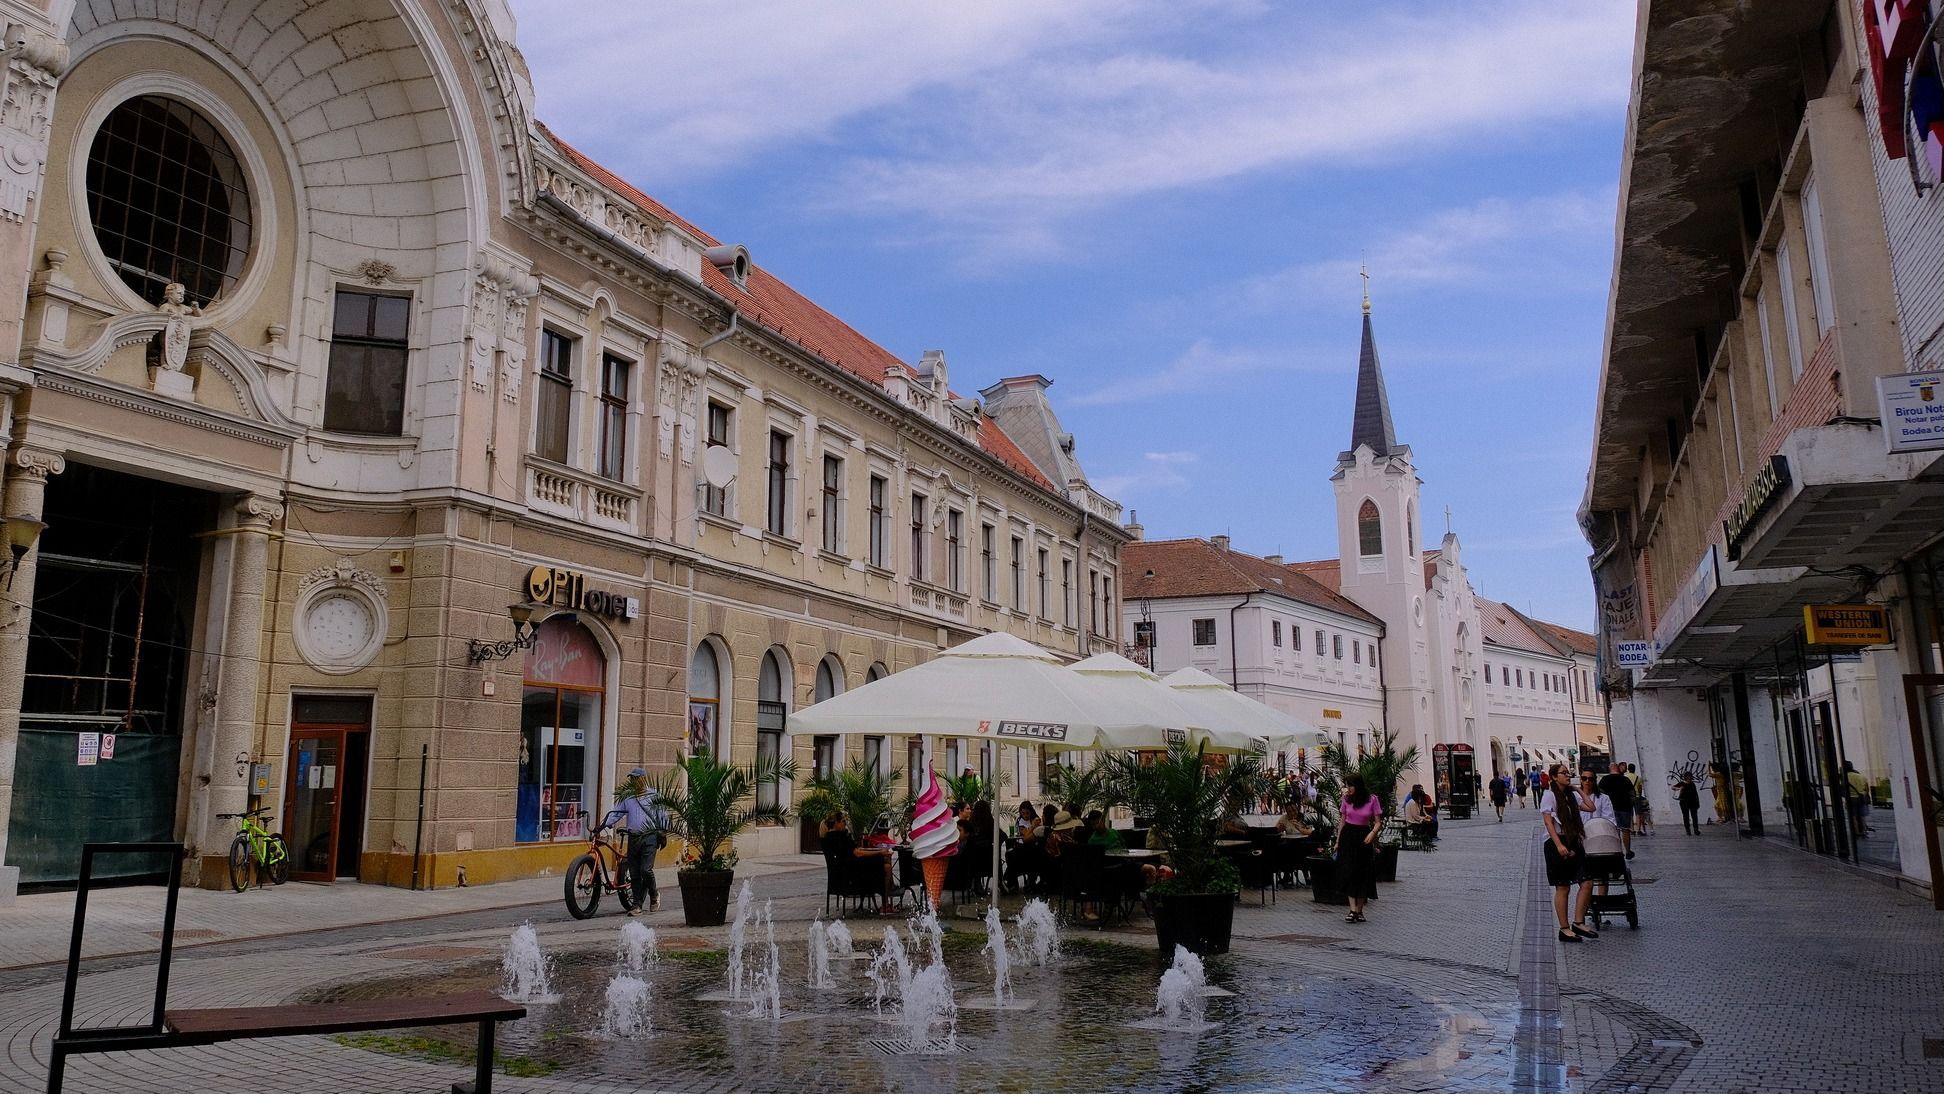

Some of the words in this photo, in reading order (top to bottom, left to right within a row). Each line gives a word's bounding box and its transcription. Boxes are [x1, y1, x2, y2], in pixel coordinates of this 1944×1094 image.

[1895, 407, 1923, 417] Birou
[1902, 427, 1932, 436] Bodea
[589, 589, 625, 617] one
[1602, 598, 1635, 613] AJE
[1817, 610, 1870, 619] WESTERN
[1834, 619, 1872, 628] UNION
[1618, 643, 1647, 652] NOTAR
[1619, 653, 1648, 662] BODEA
[1002, 722, 1065, 738] BECK'S
